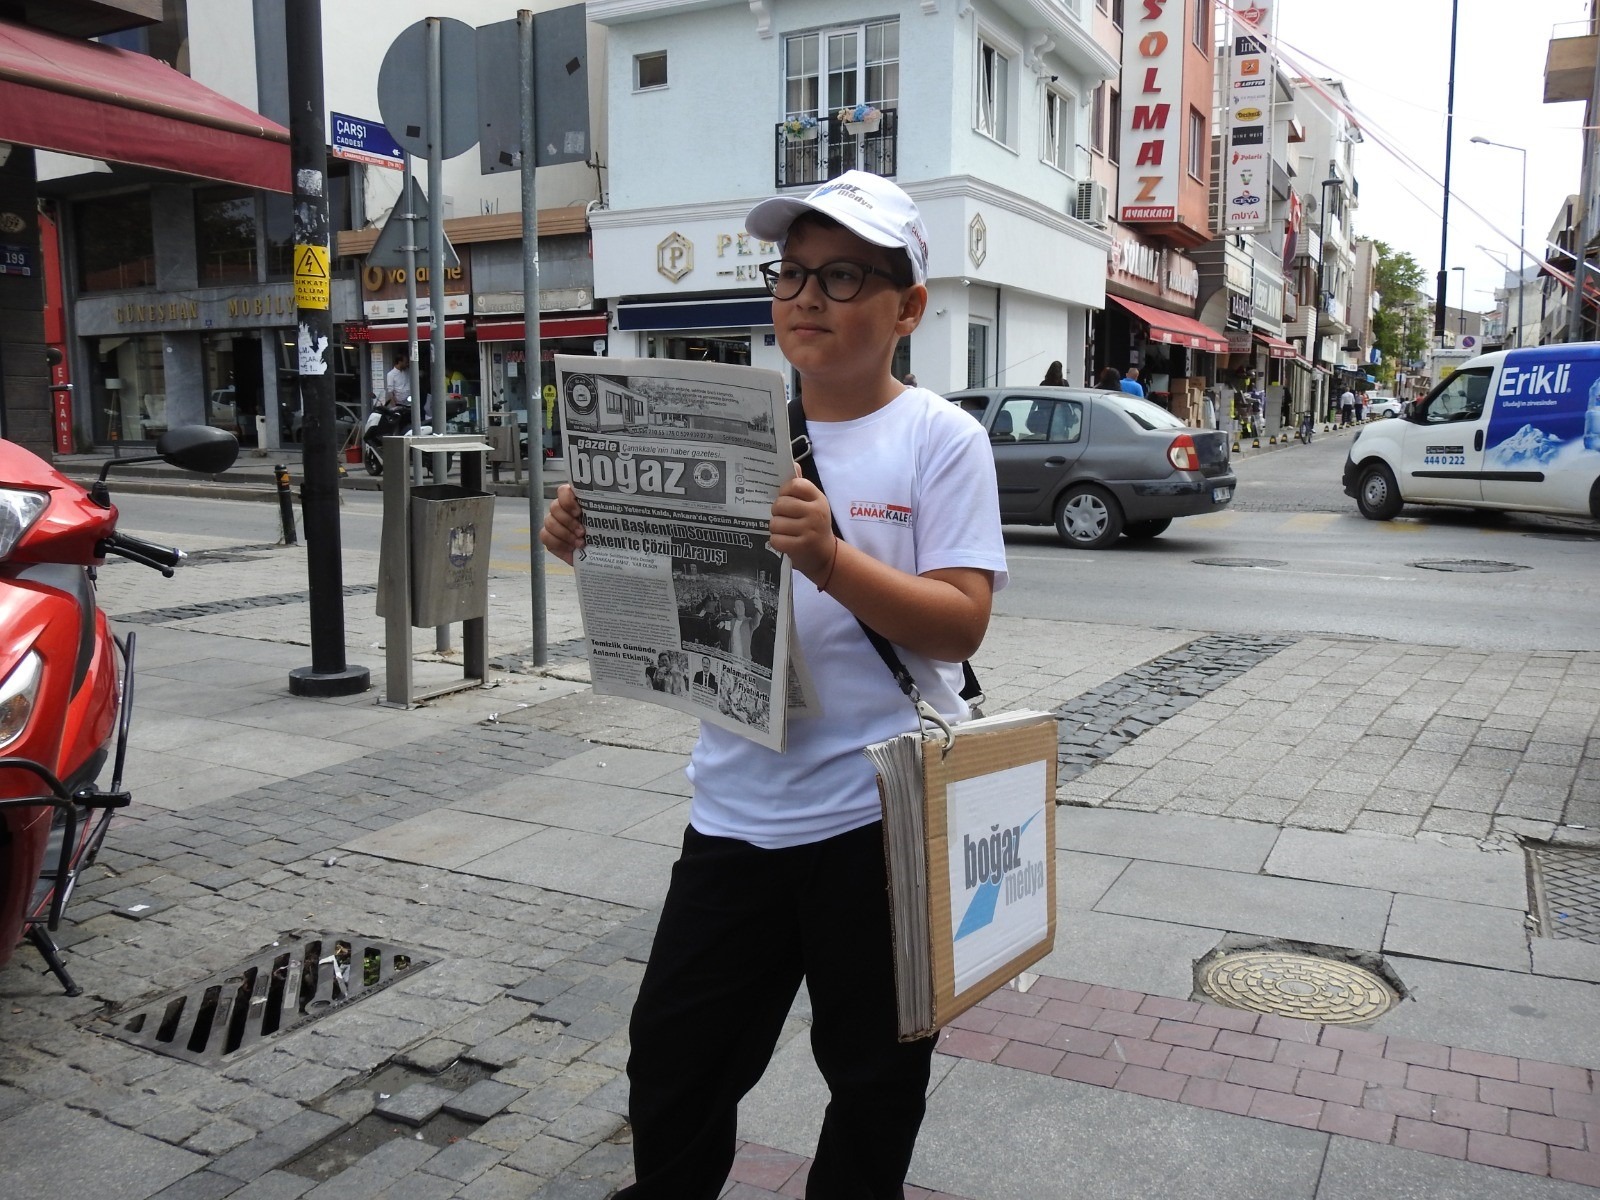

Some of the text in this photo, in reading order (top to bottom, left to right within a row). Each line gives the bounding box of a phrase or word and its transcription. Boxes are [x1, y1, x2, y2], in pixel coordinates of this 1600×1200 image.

[1132, 0, 1171, 202] SOLMAZ
[336, 120, 367, 139] ÇARŞI
[1240, 153, 1262, 161] Polaris
[837, 189, 873, 210] medya
[1125, 208, 1172, 218] AYAKKABI
[6, 253, 25, 265] 199
[386, 266, 461, 284] voane
[736, 264, 759, 281] KU
[115, 294, 298, 324] GÜNEŞHAN MOBİLY
[1499, 363, 1571, 397] Erikli
[577, 438, 617, 452] gazete
[670, 446, 689, 456] haber
[1424, 456, 1465, 464] 444 0 222
[570, 444, 686, 495] boğaz
[672, 512, 707, 521] Ankara'da
[708, 515, 732, 524] Çözüm
[733, 518, 758, 528] Arayışı
[850, 507, 908, 522] ÇANAKKALE
[687, 525, 753, 549] Sorununa,
[584, 533, 727, 566] aşkent'te Çözüm Arayışı
[591, 639, 657, 654] Temizlik Gününde
[592, 648, 621, 659] Anlamlı
[964, 824, 1021, 890] boğaz
[1005, 860, 1044, 906] medya
